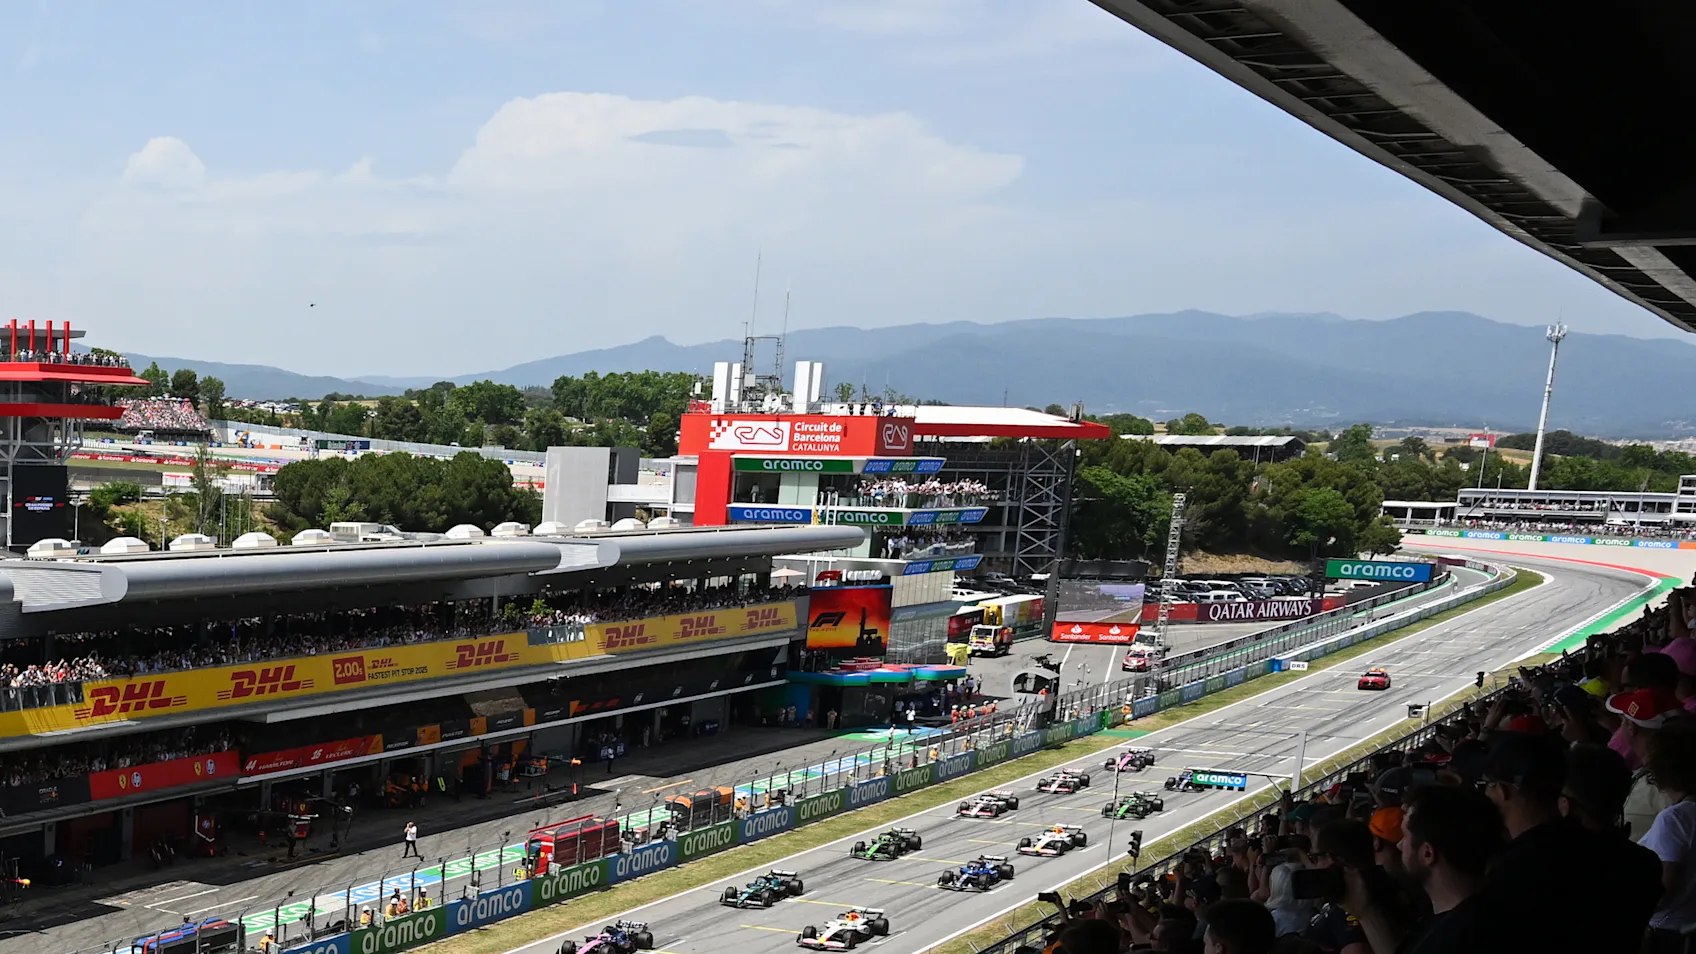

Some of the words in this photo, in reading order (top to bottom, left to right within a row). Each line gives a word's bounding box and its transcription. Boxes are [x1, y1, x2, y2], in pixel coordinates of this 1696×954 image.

[794, 421, 827, 433] Circuit
[829, 422, 842, 433] de
[793, 432, 841, 443] Barcelona
[792, 443, 840, 452] CATALUNYA
[763, 460, 823, 471] aramco
[866, 461, 889, 472] aramco
[892, 460, 916, 471] aramco
[918, 460, 941, 471] aramco
[744, 509, 803, 521] aramco
[910, 511, 933, 523] aramco
[936, 510, 959, 521] aramco
[960, 508, 984, 520] aramco
[1426, 529, 1459, 537] aramco
[1468, 531, 1500, 539] aramco
[1509, 533, 1543, 541] aramco
[1552, 536, 1586, 544] aramco
[1595, 538, 1630, 546] aramco
[1638, 540, 1672, 548] aramco
[905, 561, 929, 573] aramco
[930, 560, 953, 570] aramco
[955, 557, 979, 569] aramco
[1340, 562, 1415, 578] aramco
[1209, 603, 1253, 621] QATAR
[1256, 600, 1312, 618] AIRWAYS
[747, 608, 783, 628] DHL
[680, 616, 719, 637] DHL
[605, 624, 648, 648] DHL
[455, 641, 509, 668] DHL
[371, 658, 394, 669] DHL
[368, 670, 391, 680] FASTEST
[401, 668, 414, 677] STOP
[415, 666, 428, 675] 2025
[230, 665, 301, 699] DHL
[89, 680, 172, 717] DHL
[1046, 723, 1072, 743] aramco
[1014, 732, 1040, 753] aramco
[325, 750, 354, 759] LECLERC
[977, 743, 1007, 764] aramco
[246, 760, 257, 771] 44
[259, 760, 294, 770] HAMILTON
[939, 754, 969, 777] aramco
[896, 766, 930, 790] aramco
[1196, 774, 1243, 786] aramco
[851, 779, 887, 803] aramco
[801, 791, 840, 818] aramco
[745, 807, 789, 834] aramco
[684, 826, 732, 854] aramco
[617, 844, 669, 876] aramco
[541, 865, 600, 899] aramco
[457, 887, 523, 926] aramco
[362, 914, 436, 954] aramco
